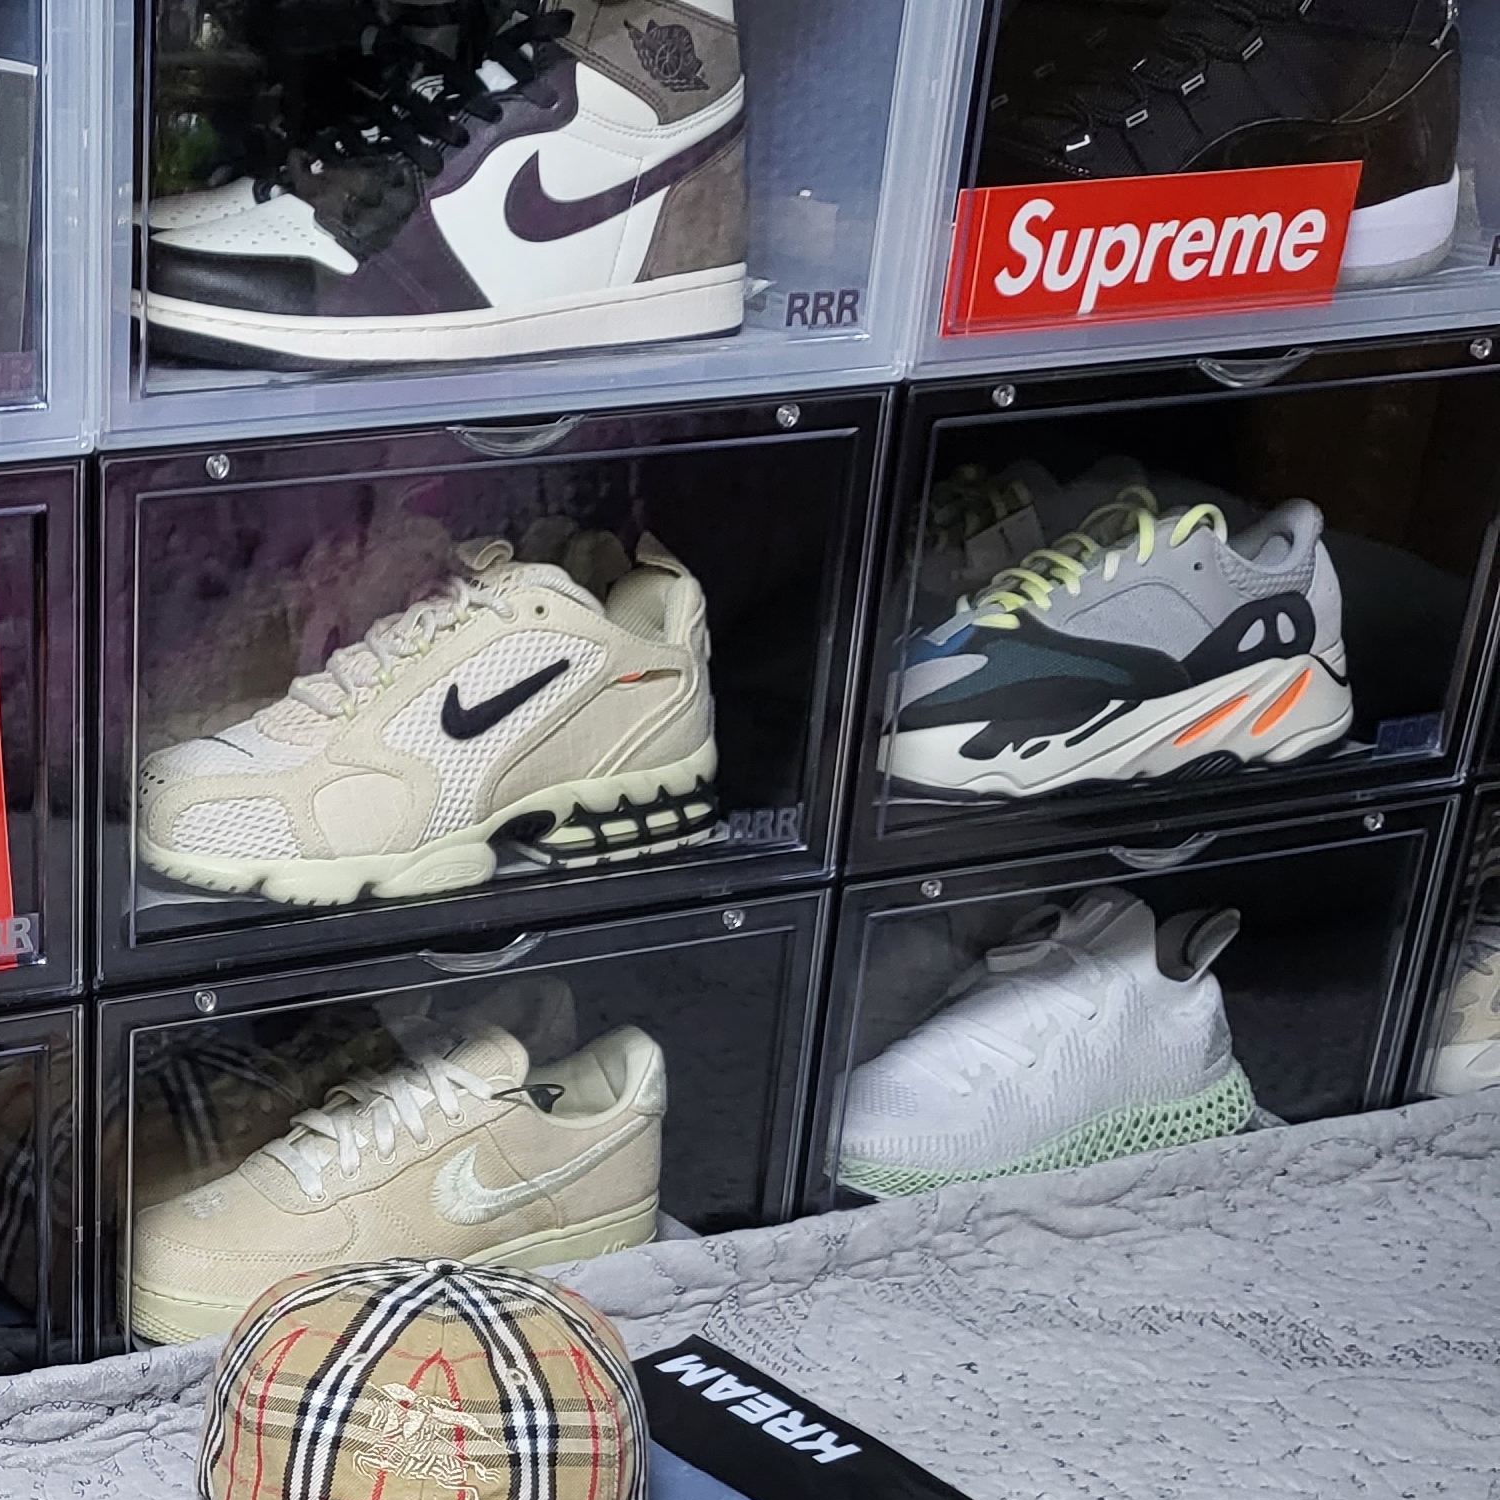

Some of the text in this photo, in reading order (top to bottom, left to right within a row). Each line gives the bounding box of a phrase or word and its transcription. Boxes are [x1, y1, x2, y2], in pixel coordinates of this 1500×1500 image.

[785, 289, 859, 327] RRR
[994, 198, 1326, 315] Supreme
[654, 1353, 863, 1465] KREAM
